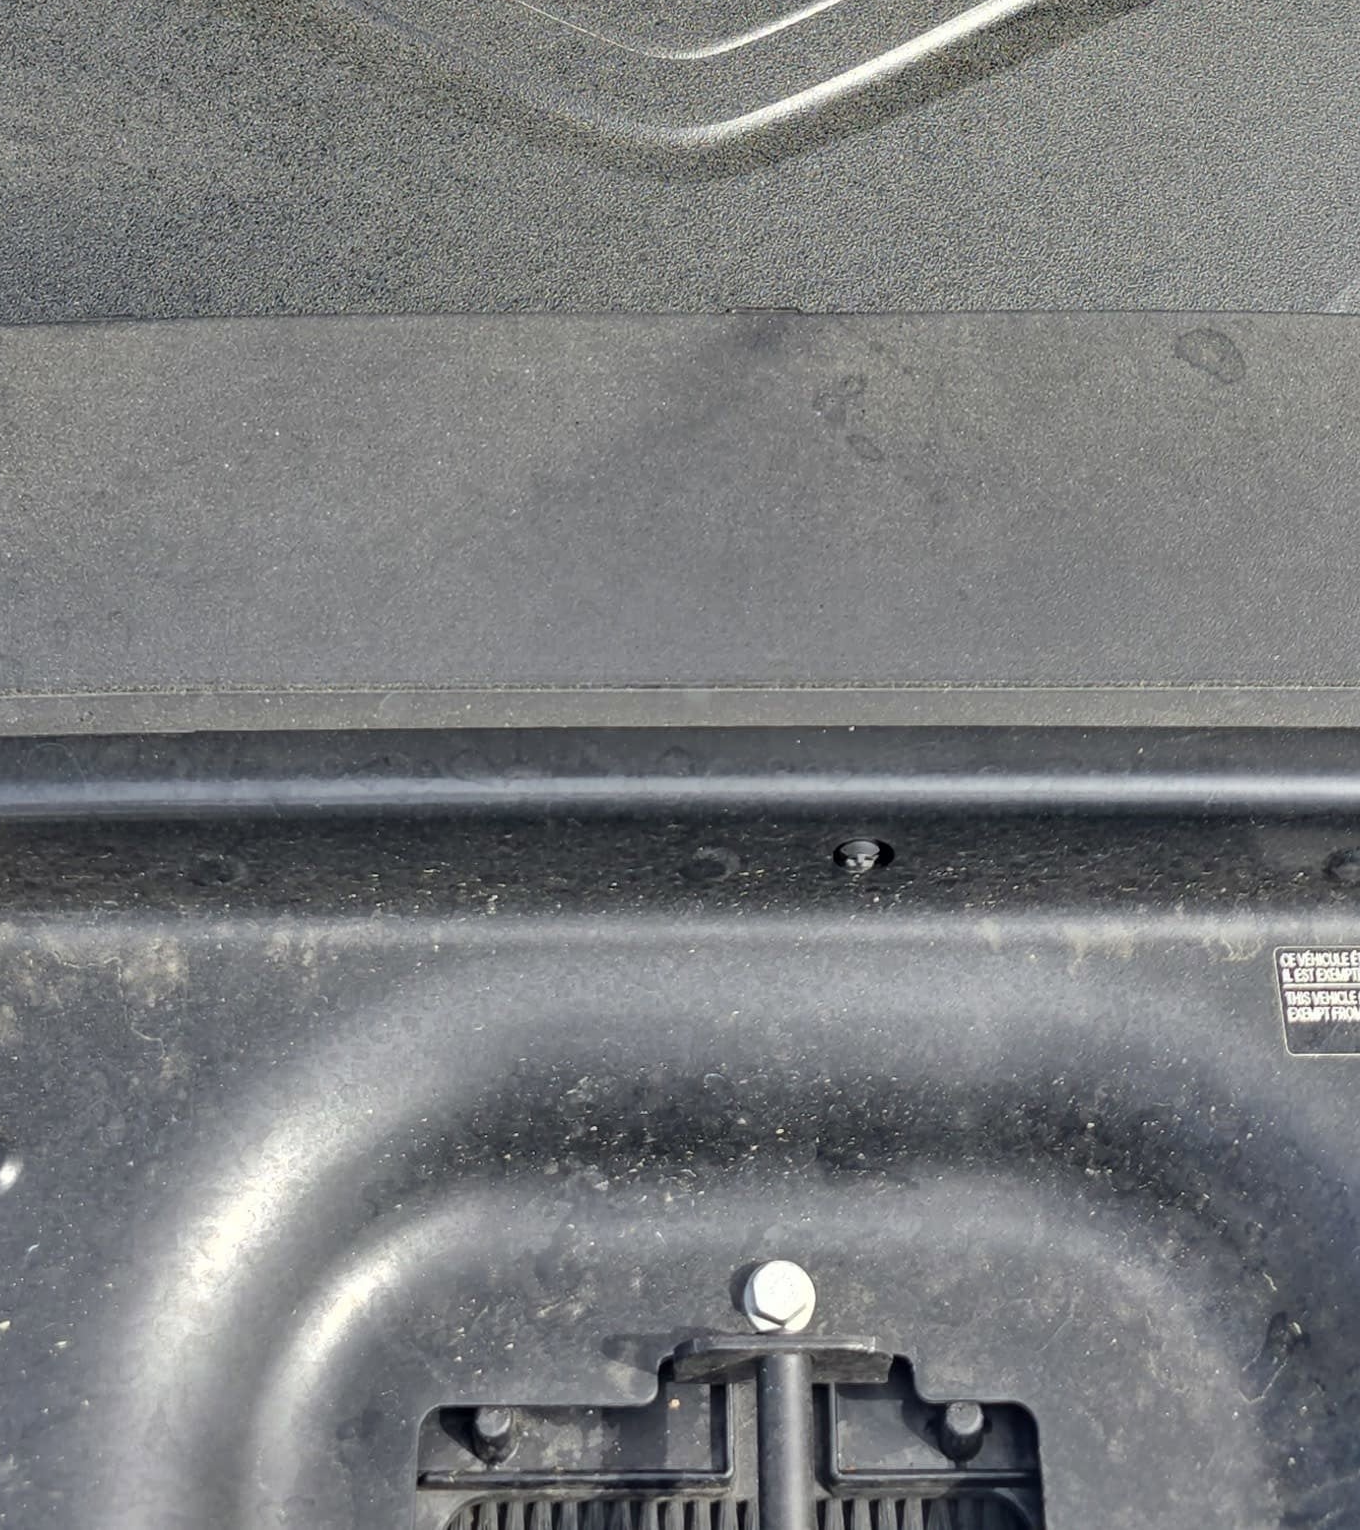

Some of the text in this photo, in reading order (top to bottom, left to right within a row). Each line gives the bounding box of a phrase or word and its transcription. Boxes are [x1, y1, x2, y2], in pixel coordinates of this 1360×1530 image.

[1297, 949, 1350, 967] VÉHICULE
[1294, 968, 1315, 981] EST
[1285, 990, 1311, 1005] THIS
[1311, 990, 1359, 1005] VEHICLE
[1287, 1006, 1331, 1022] EXEMPT
